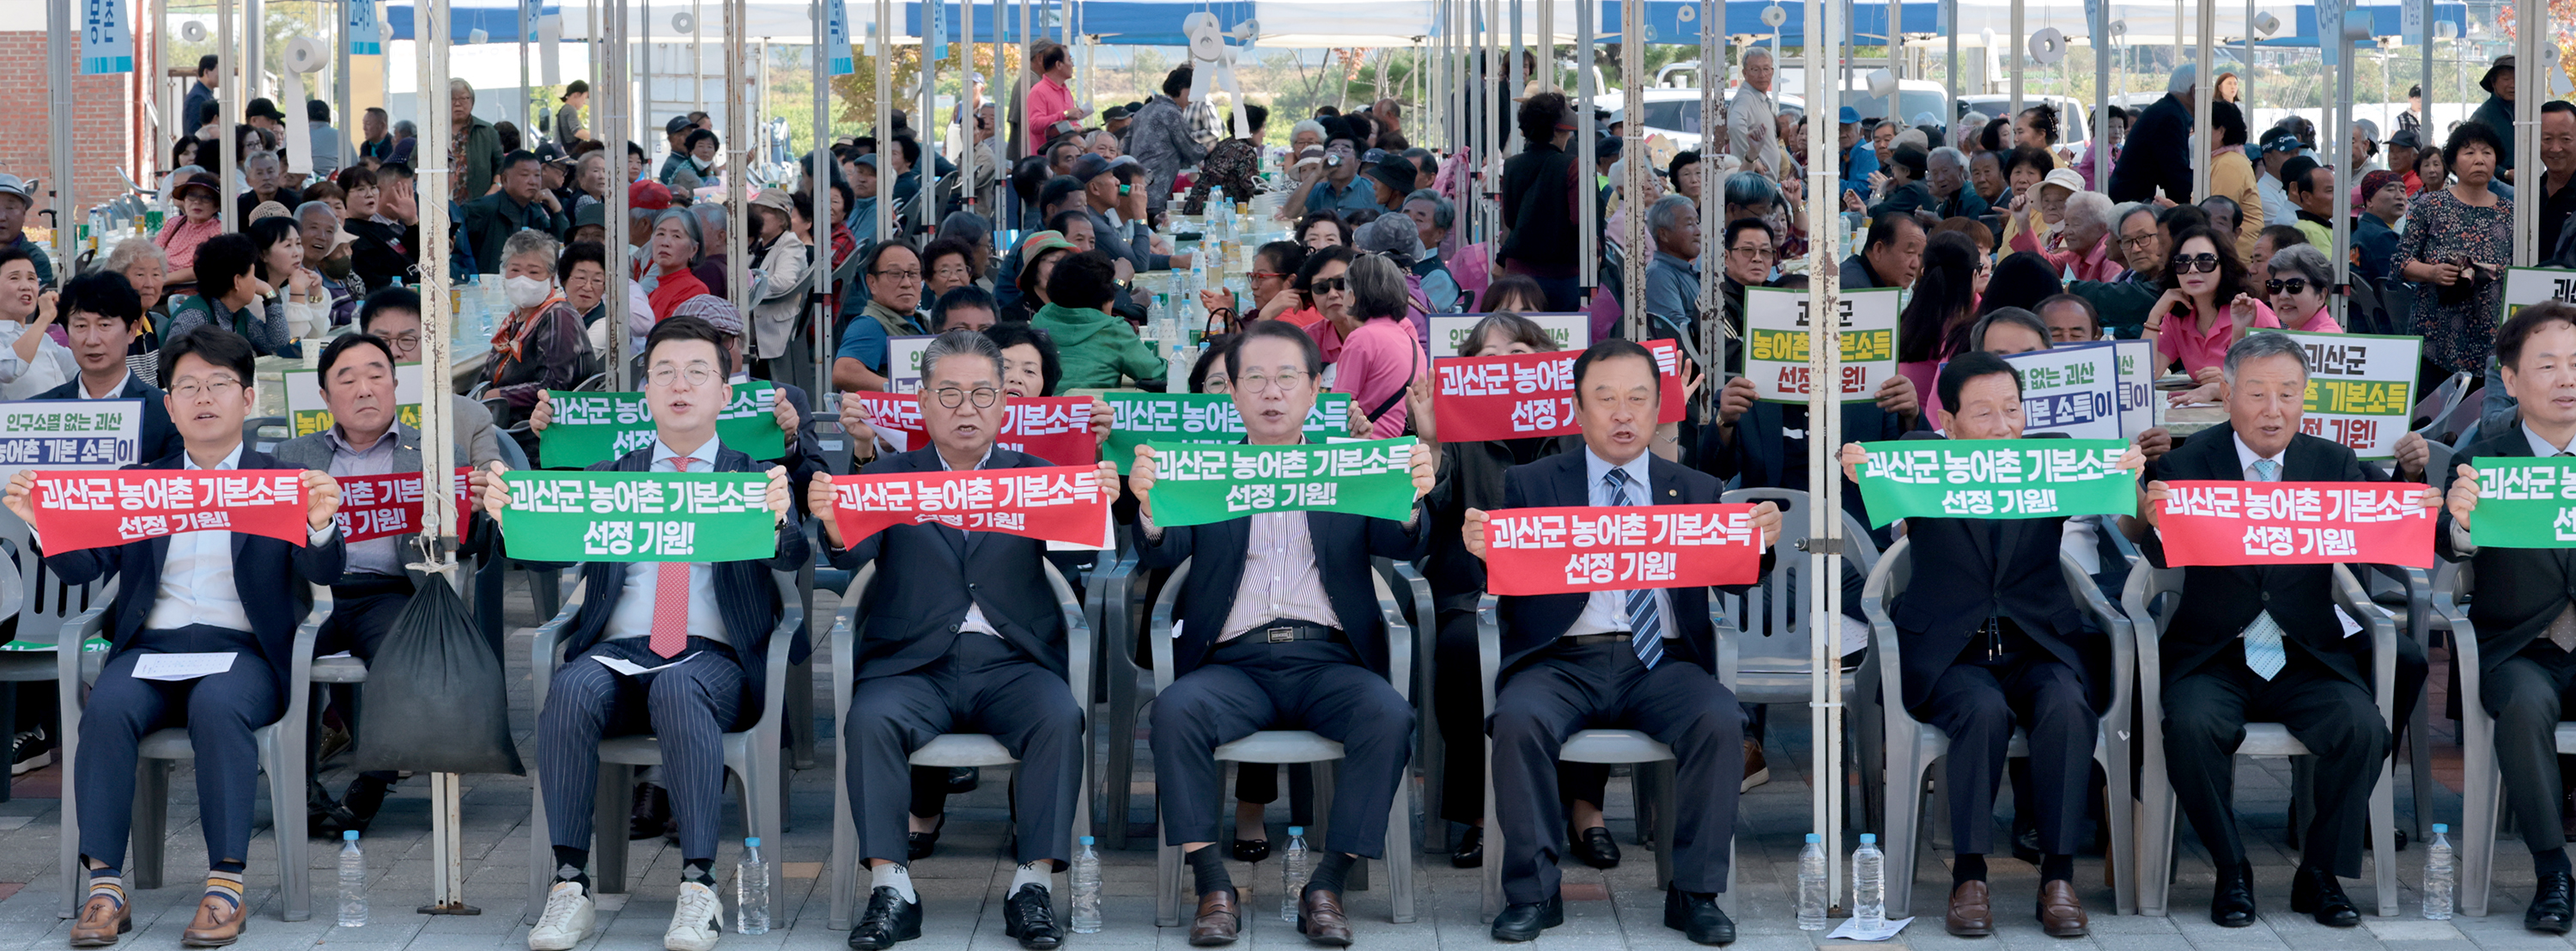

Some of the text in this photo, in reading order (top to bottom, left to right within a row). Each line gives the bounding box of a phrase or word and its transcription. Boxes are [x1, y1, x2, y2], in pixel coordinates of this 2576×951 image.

[1796, 300, 1853, 327] 괴군
[1840, 331, 1891, 361] 본소득
[2304, 344, 2366, 375] 괴산군
[1439, 363, 1510, 396] 괴산군
[1841, 366, 1866, 393] 원!
[2030, 367, 2061, 391] 없는
[2064, 362, 2095, 386] 괴산
[2117, 355, 2135, 375] 산
[2325, 381, 2407, 414] 기본소득
[6, 412, 122, 431] 인구소멸 없는 괴산
[1000, 404, 1093, 436] 기본소득
[1111, 399, 1177, 432] 괴산군
[1302, 400, 1347, 432] 소득
[1511, 399, 1557, 432] 선정
[2330, 418, 2378, 449] 기원!
[44, 439, 77, 463] 기본
[1153, 443, 1412, 481] 괴산군 농어촌 기본소득
[1864, 448, 2128, 485] 괴산군 농어촌 기본소득
[37, 476, 299, 511] 괴산군 농어촌 기본소득
[508, 479, 769, 514] 괴산군 농어촌 기본소득
[836, 472, 1099, 512] 괴산군 농어촌 기본소득
[1225, 482, 1338, 513] 선정 기원!
[2477, 466, 2556, 500] 괴산군
[1941, 488, 2059, 515] 선정 기원!
[2165, 486, 2427, 523] 괴산군 농어촌 기본소득
[117, 510, 232, 540] 선정 기원!
[355, 507, 409, 535] 기원!
[969, 511, 1025, 531] 기원!
[1490, 512, 1753, 549] 괴산군 농어촌 기본소득
[583, 520, 696, 556] 선정 기원!
[2242, 525, 2358, 557] 선정 기원!
[1564, 551, 1677, 585] 선정 기원!
